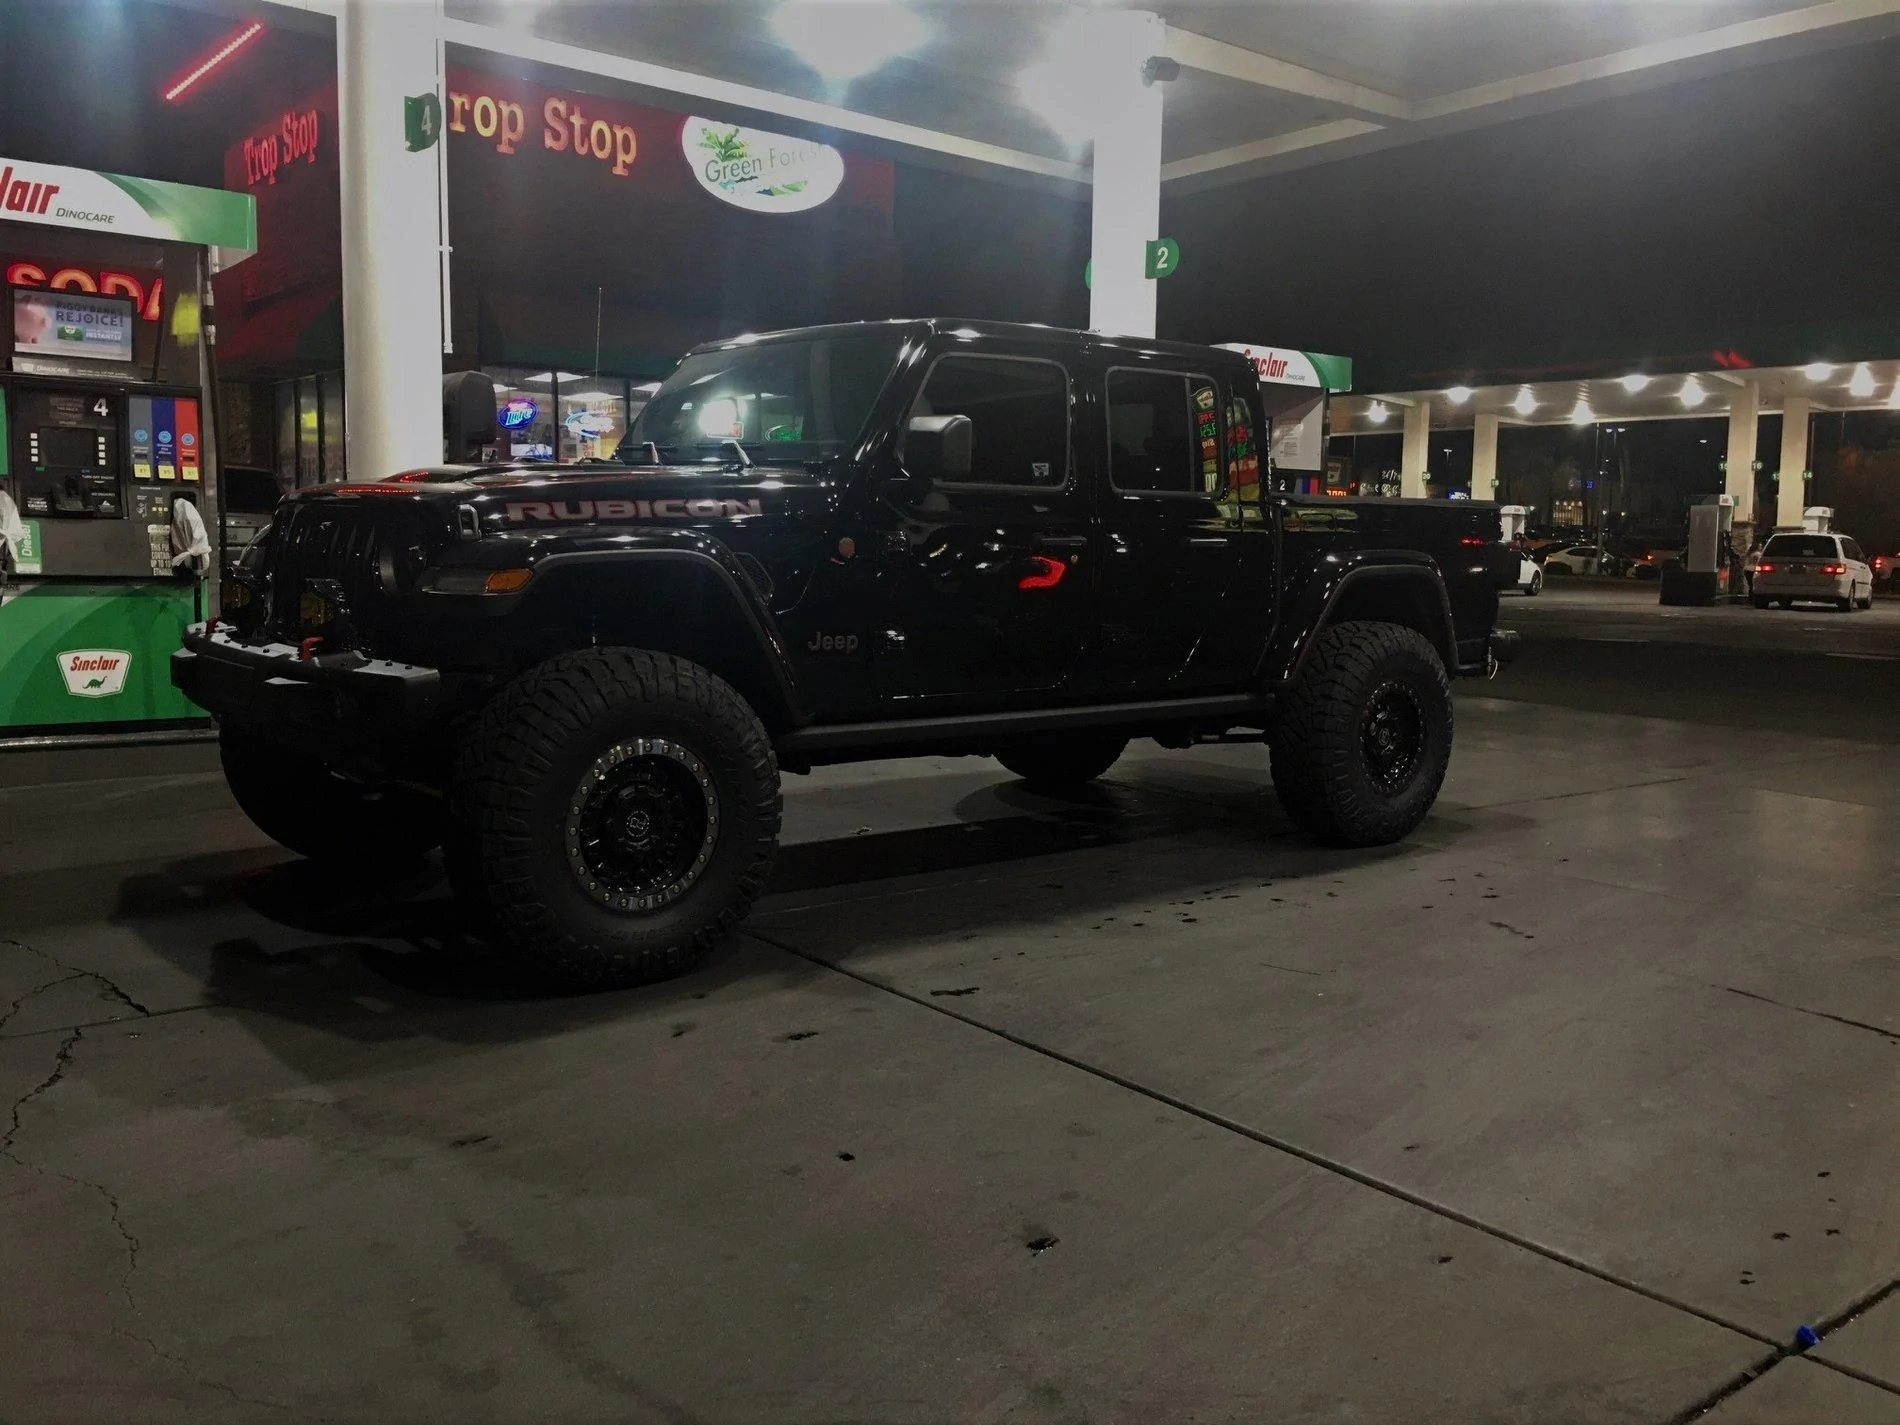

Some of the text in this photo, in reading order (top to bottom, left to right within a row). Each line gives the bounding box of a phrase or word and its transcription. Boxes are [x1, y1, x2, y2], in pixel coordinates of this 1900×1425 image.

[421, 105, 432, 136] 4
[449, 91, 637, 176] rop Stop
[243, 109, 318, 186] Trop Stop
[705, 157, 762, 183] Green
[0, 166, 60, 214] lair
[56, 207, 116, 224] DINOCARE
[1156, 246, 1169, 269] 2
[56, 310, 124, 327] REJOICE!
[1244, 349, 1288, 378] Snclair
[93, 398, 109, 416] 4
[1279, 479, 1286, 491] 2
[506, 499, 764, 523] RUBICON
[807, 631, 859, 655] Jeep
[71, 657, 120, 671] Sinclair
